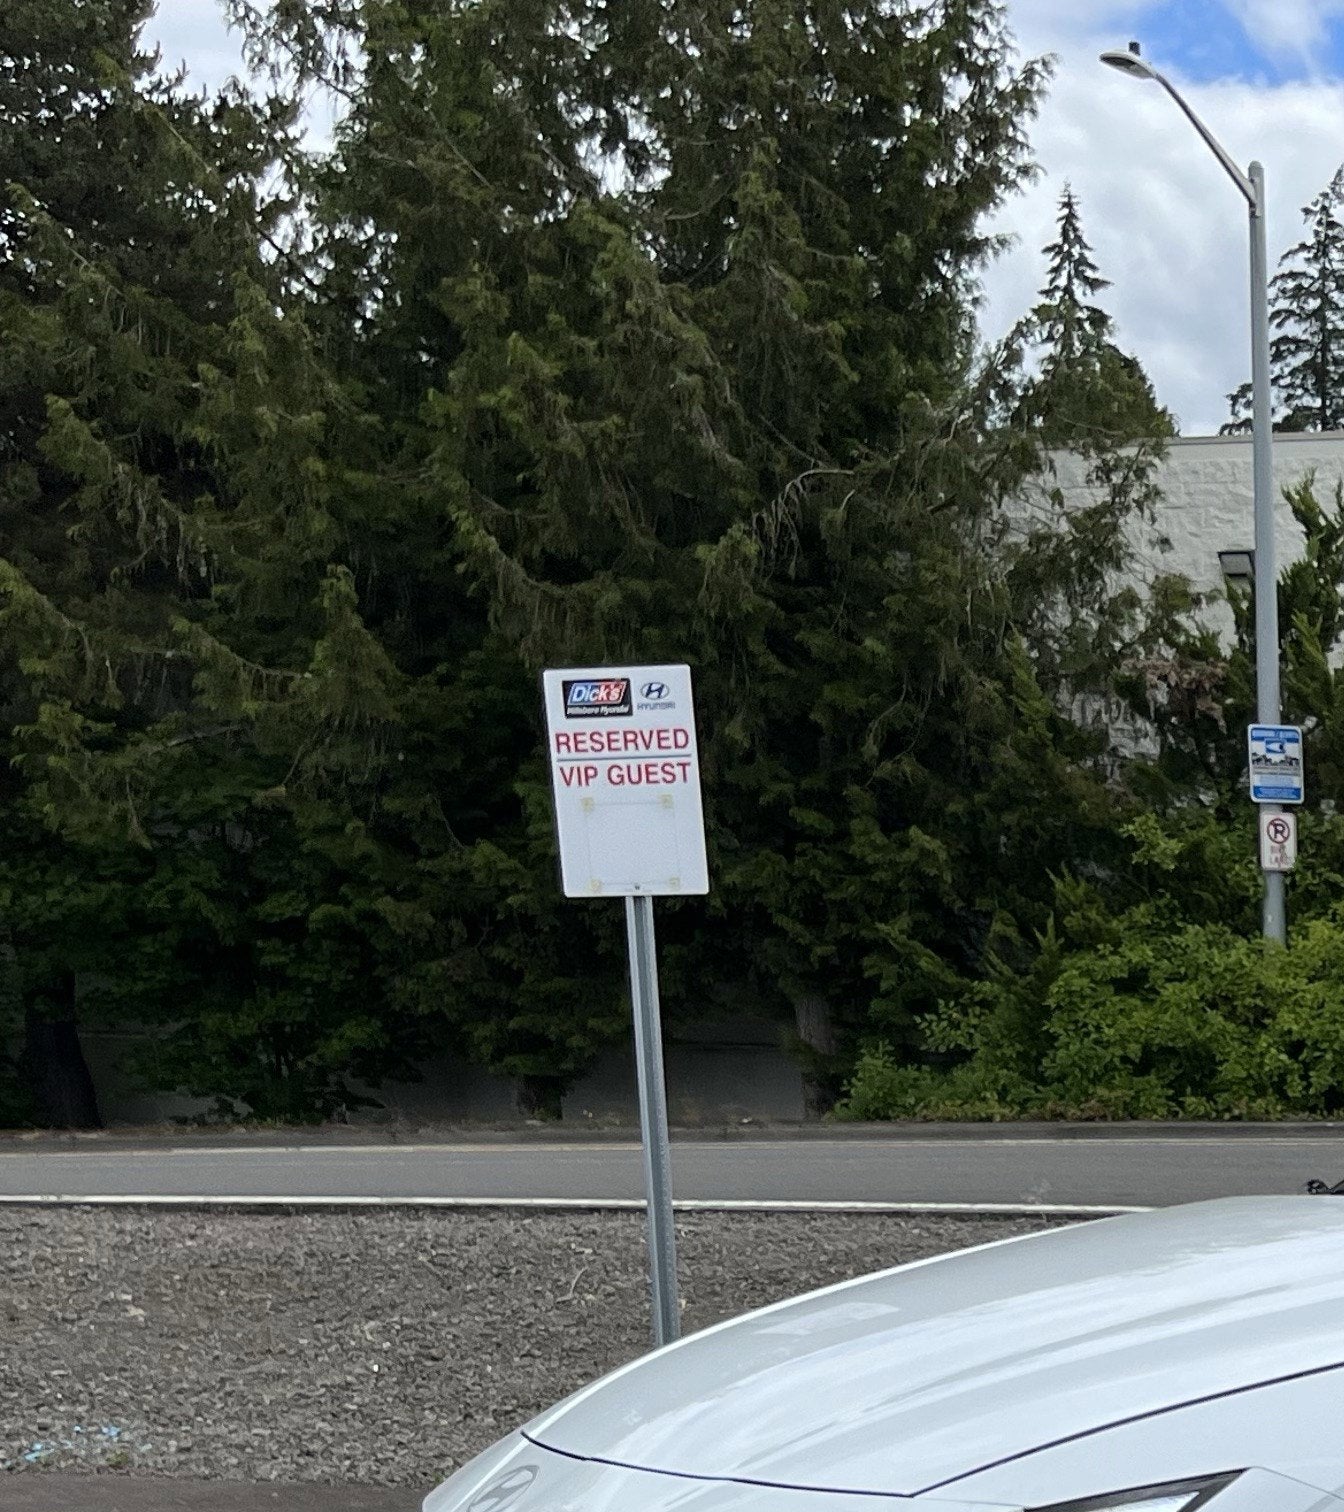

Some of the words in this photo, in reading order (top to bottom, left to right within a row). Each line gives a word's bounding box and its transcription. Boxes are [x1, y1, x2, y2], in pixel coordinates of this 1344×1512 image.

[555, 727, 690, 755] RESERVED
[559, 765, 599, 788] VIP
[607, 761, 691, 786] GUEST
